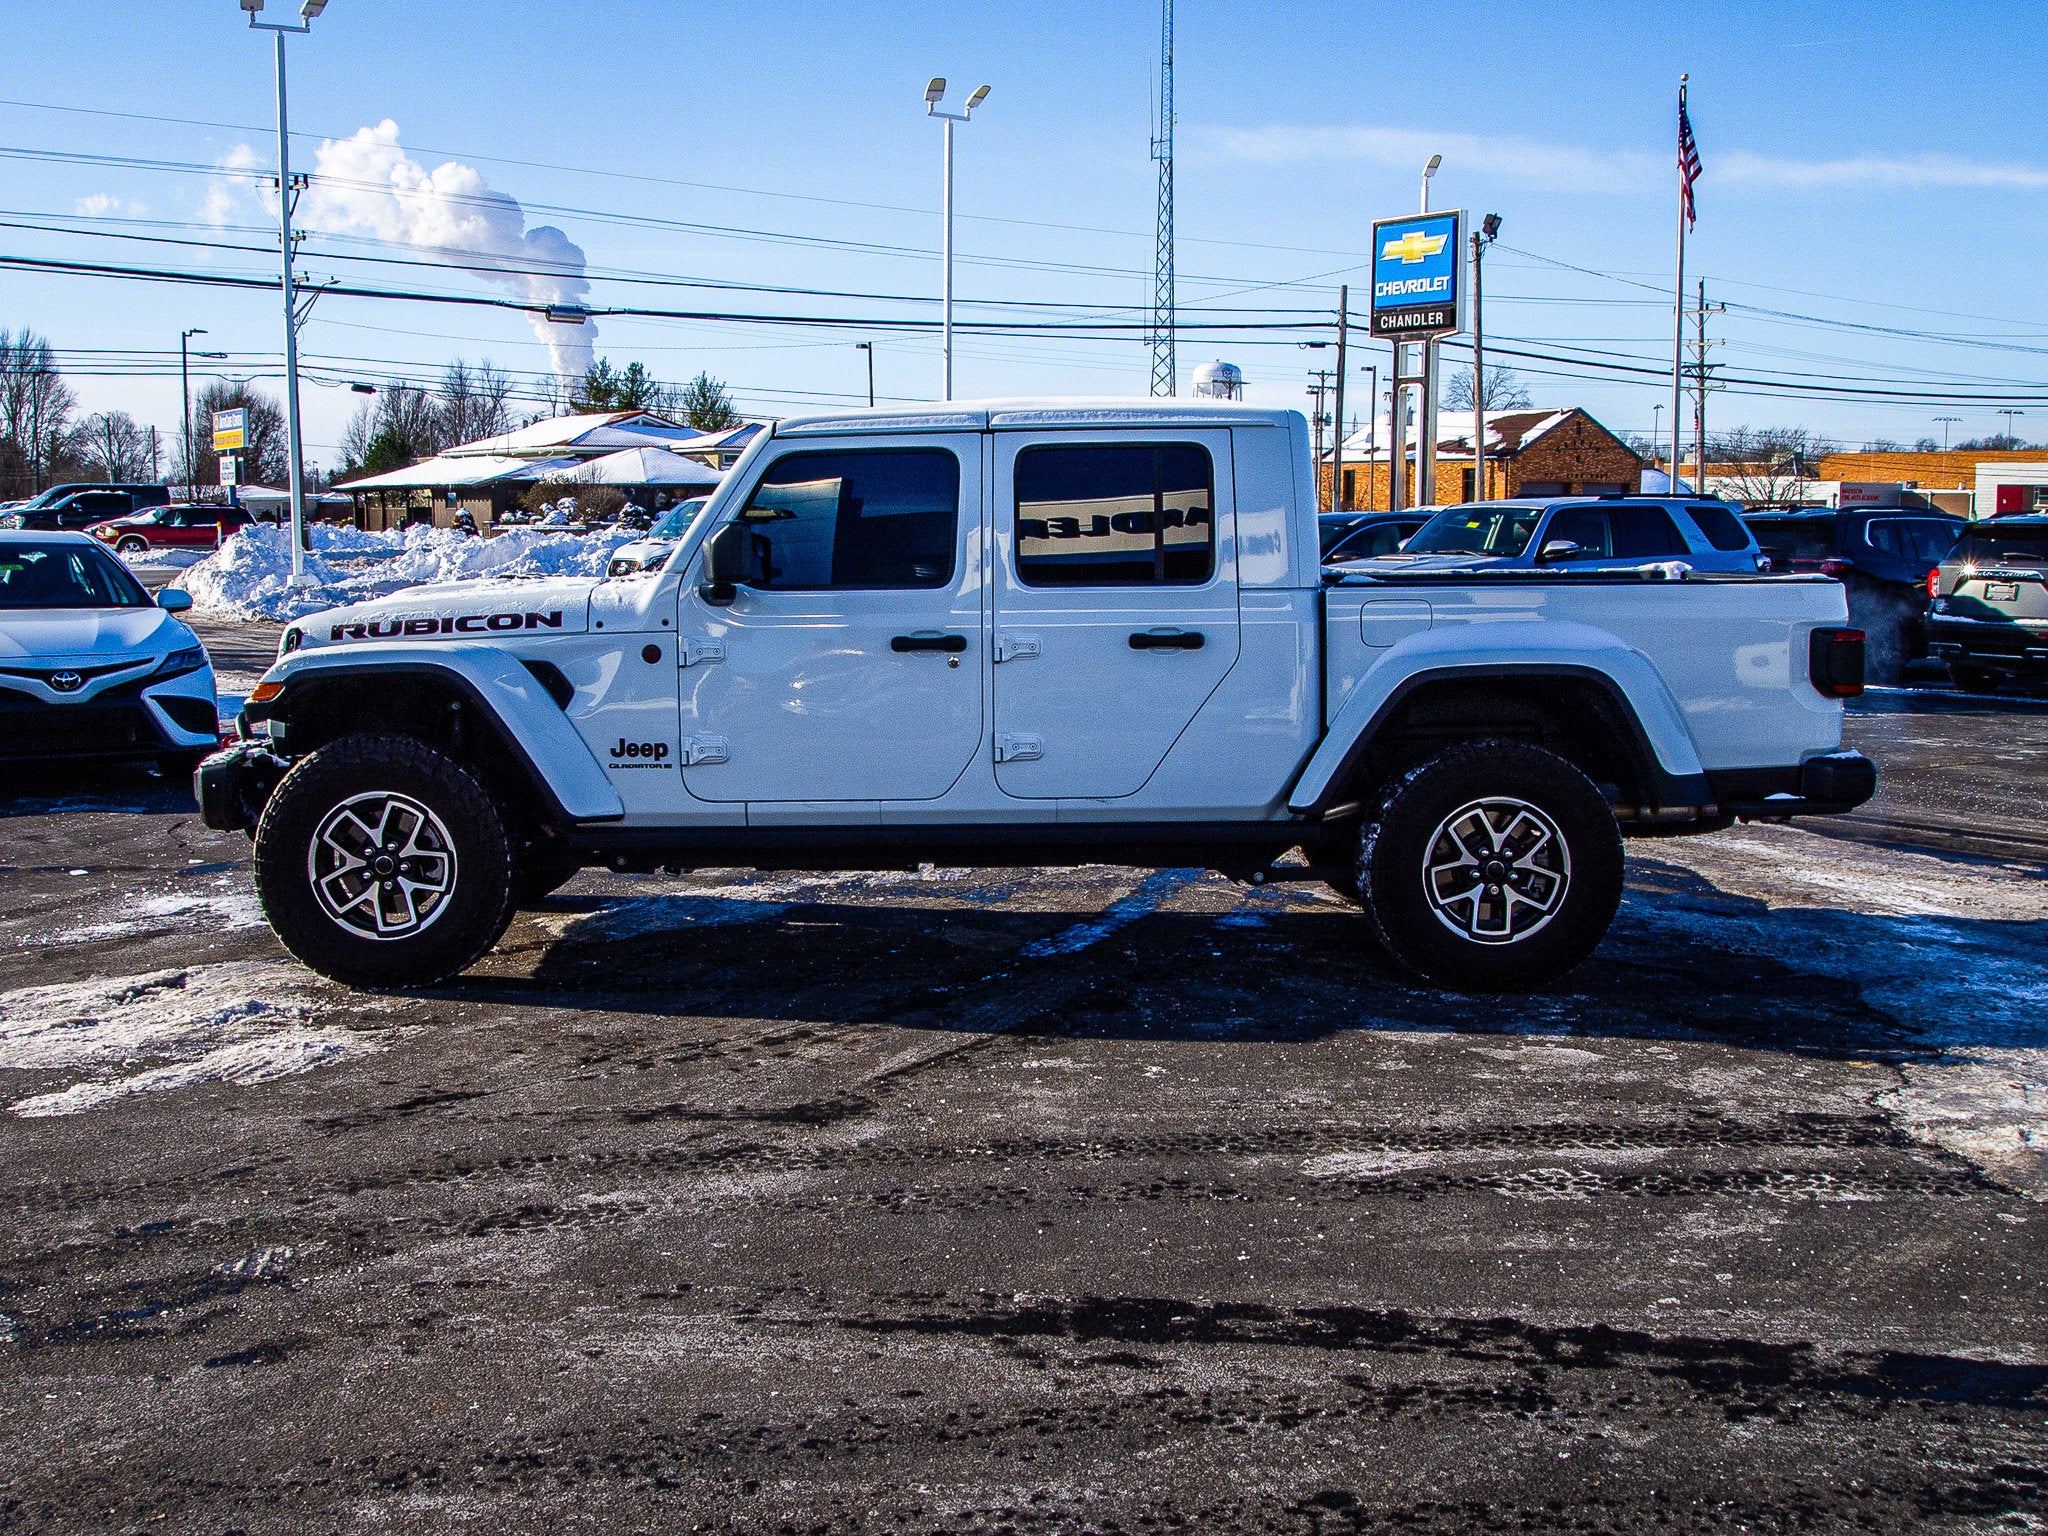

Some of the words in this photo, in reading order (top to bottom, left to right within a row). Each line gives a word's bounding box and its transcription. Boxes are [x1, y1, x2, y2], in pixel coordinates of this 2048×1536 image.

[1375, 275, 1450, 297] CHEVROLET
[1380, 311, 1444, 329] CHANDLER
[330, 610, 563, 641] RUBICON
[610, 738, 669, 761] Jeep
